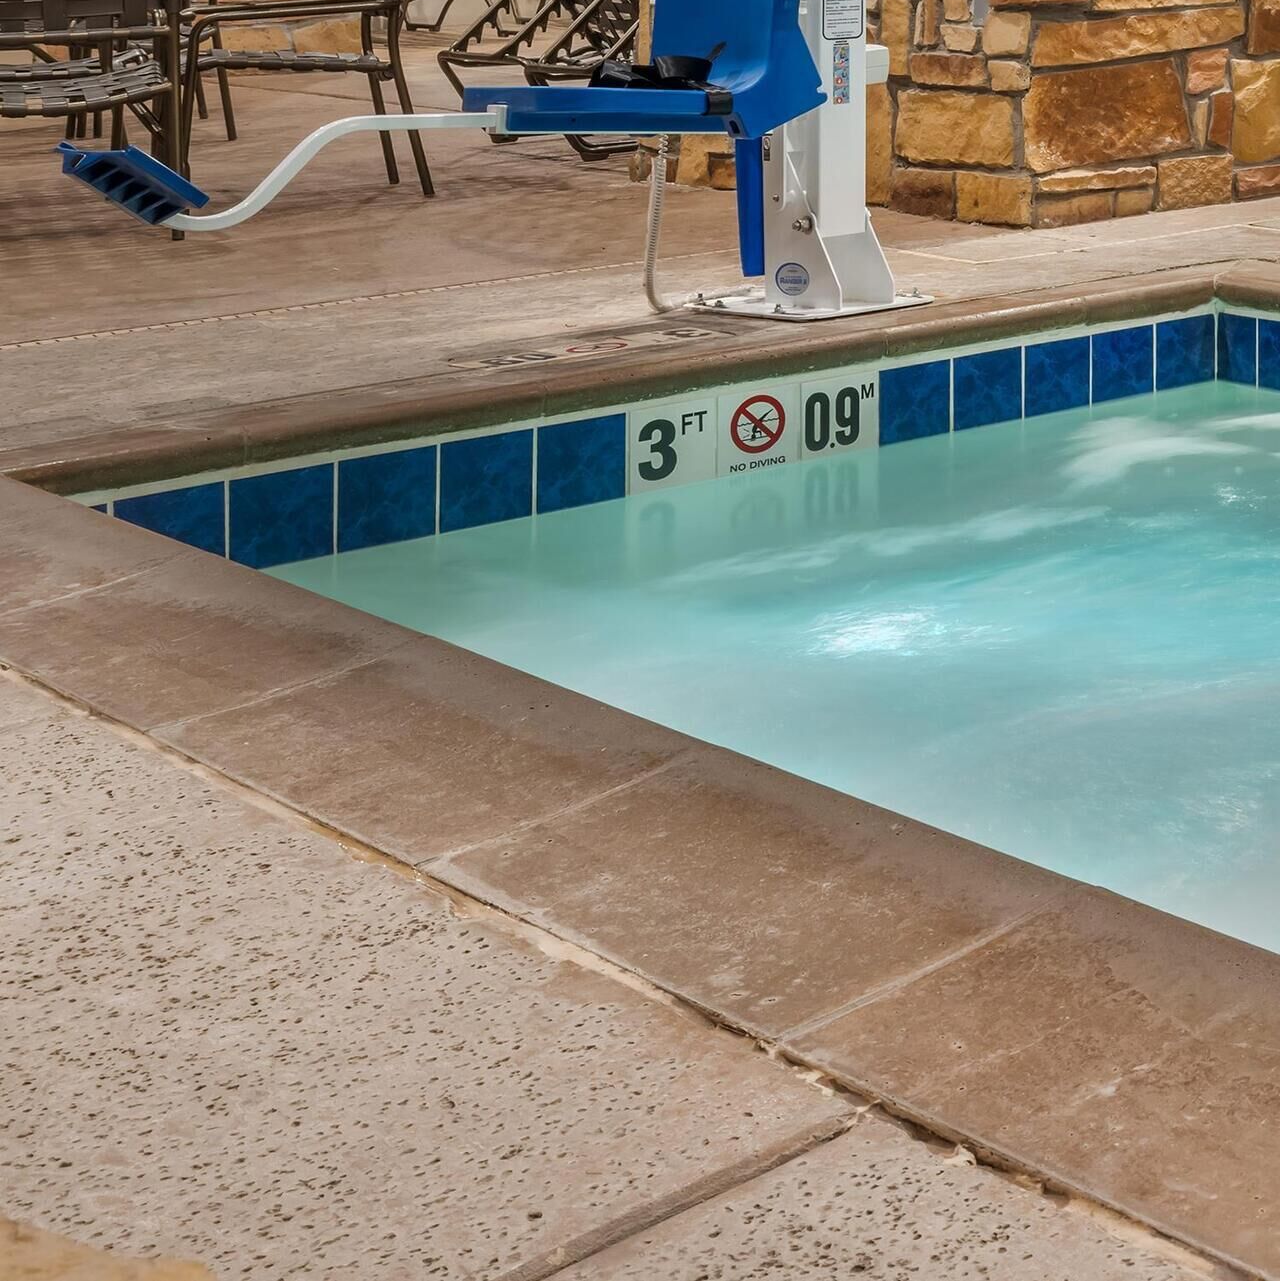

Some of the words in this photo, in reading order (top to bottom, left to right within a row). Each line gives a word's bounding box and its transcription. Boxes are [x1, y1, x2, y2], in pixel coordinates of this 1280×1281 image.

[638, 418, 678, 482] 3
[681, 410, 708, 436] FT
[804, 386, 861, 452] 0.9
[860, 382, 875, 401] M
[729, 462, 746, 474] NO
[750, 455, 787, 470] DIVING
